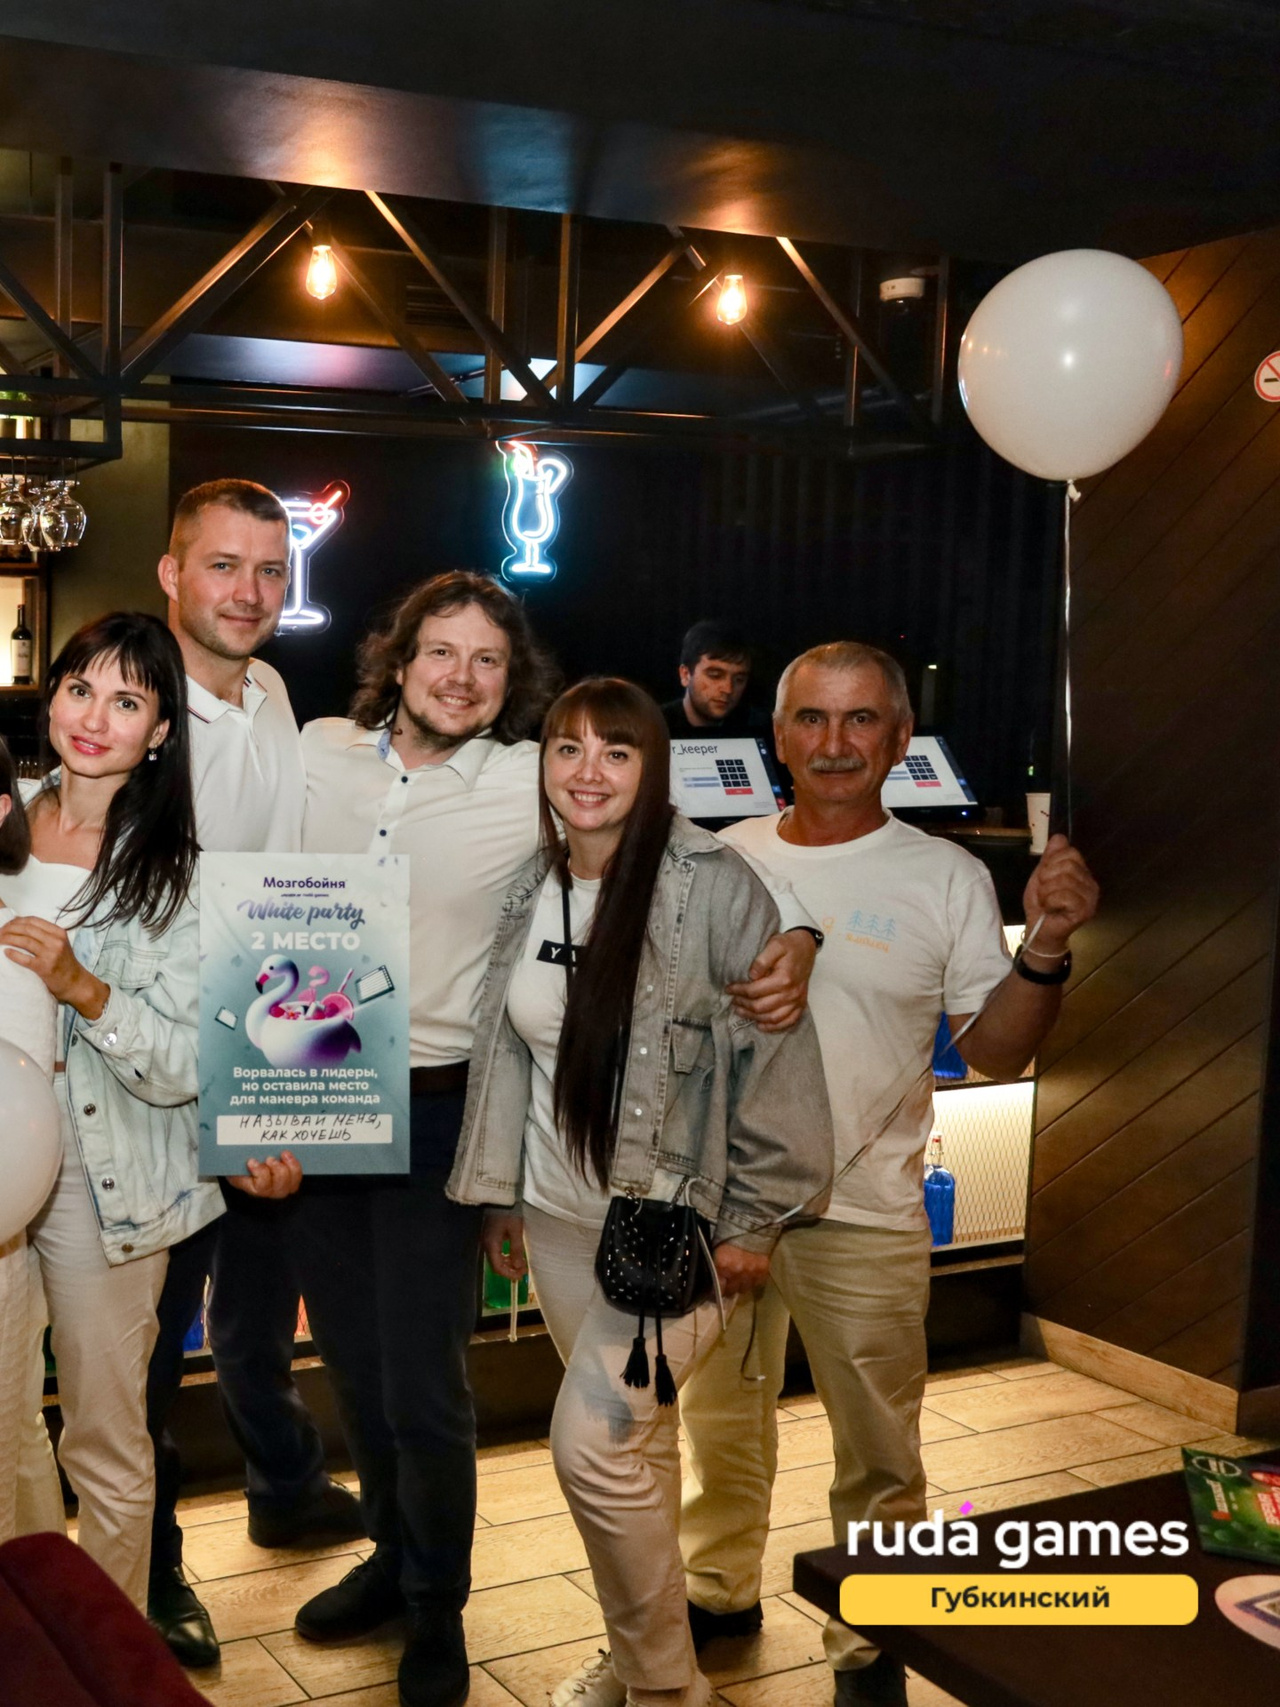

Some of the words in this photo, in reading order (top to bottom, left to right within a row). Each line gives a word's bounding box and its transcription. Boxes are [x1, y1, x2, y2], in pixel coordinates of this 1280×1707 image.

[672, 744, 718, 756] r_keeper
[263, 877, 346, 889] Мозгобойня
[237, 897, 306, 921] White
[306, 902, 366, 930] party
[251, 931, 266, 950] 2
[272, 931, 361, 951] МЕСТО
[233, 1067, 306, 1080] Ворвалась
[310, 1069, 318, 1077] в
[321, 1068, 378, 1080] лидеры,
[242, 1082, 260, 1091] но
[262, 1082, 325, 1091] оставила
[329, 1081, 369, 1090] место
[230, 1095, 256, 1106] для
[259, 1095, 318, 1106] маневра
[321, 1094, 381, 1104] команда
[240, 1111, 326, 1129] НАЗЫВАЙ
[260, 1130, 288, 1142] КАК
[291, 1128, 352, 1142] ХОЧЕШЬ
